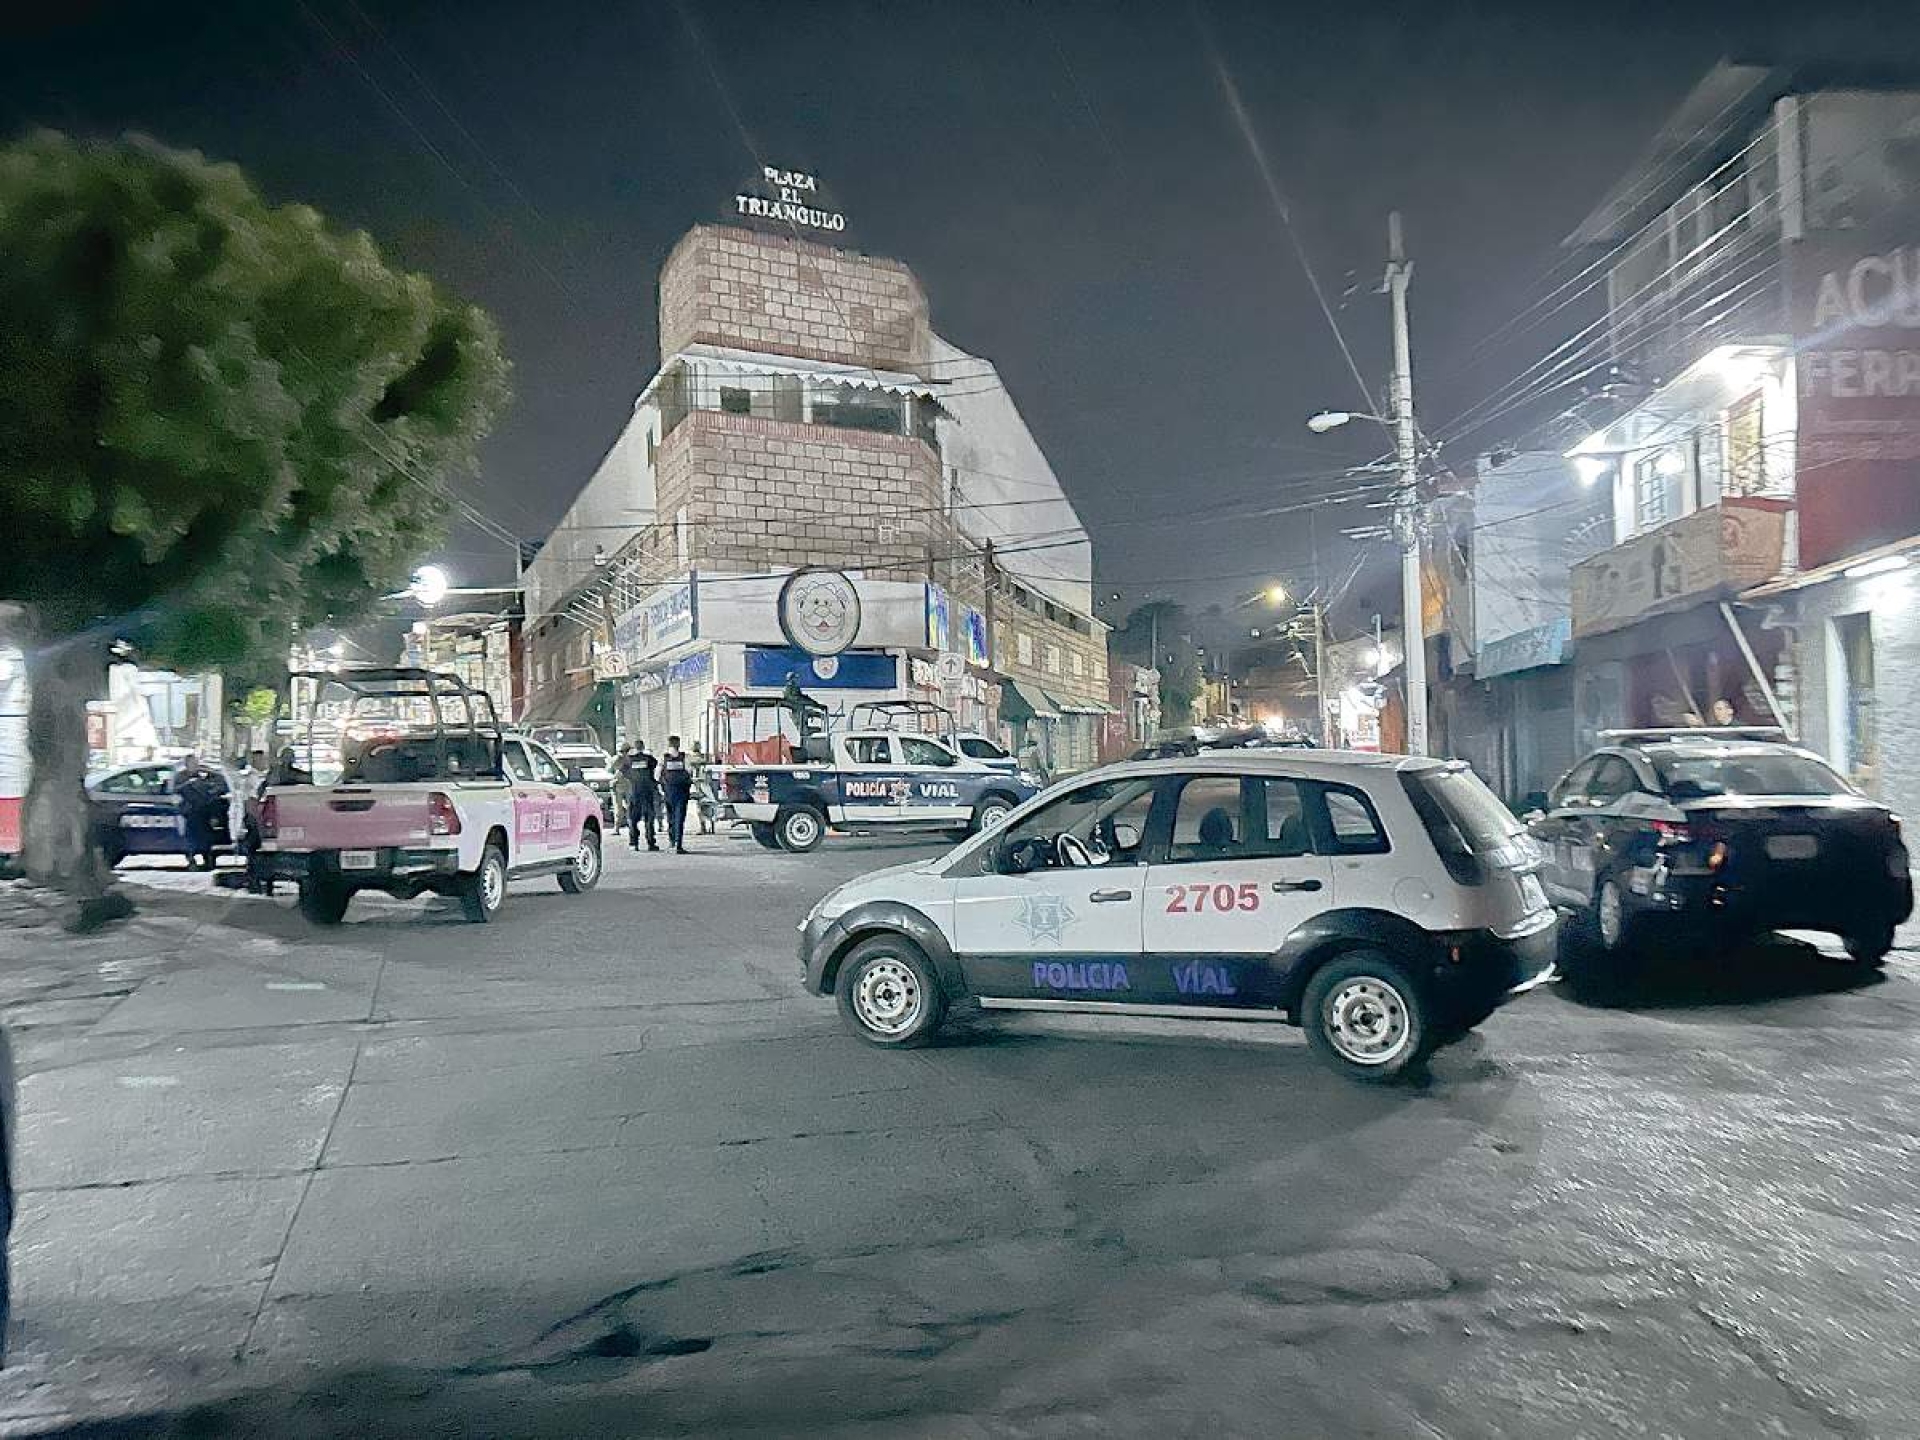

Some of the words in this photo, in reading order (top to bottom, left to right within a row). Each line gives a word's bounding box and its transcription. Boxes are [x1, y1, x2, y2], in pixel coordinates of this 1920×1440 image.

[764, 166, 817, 192] PLAZA
[781, 187, 803, 204] EL
[736, 195, 845, 231] TRIANGULO
[920, 783, 959, 798] VIAL
[1166, 883, 1260, 913] 2705
